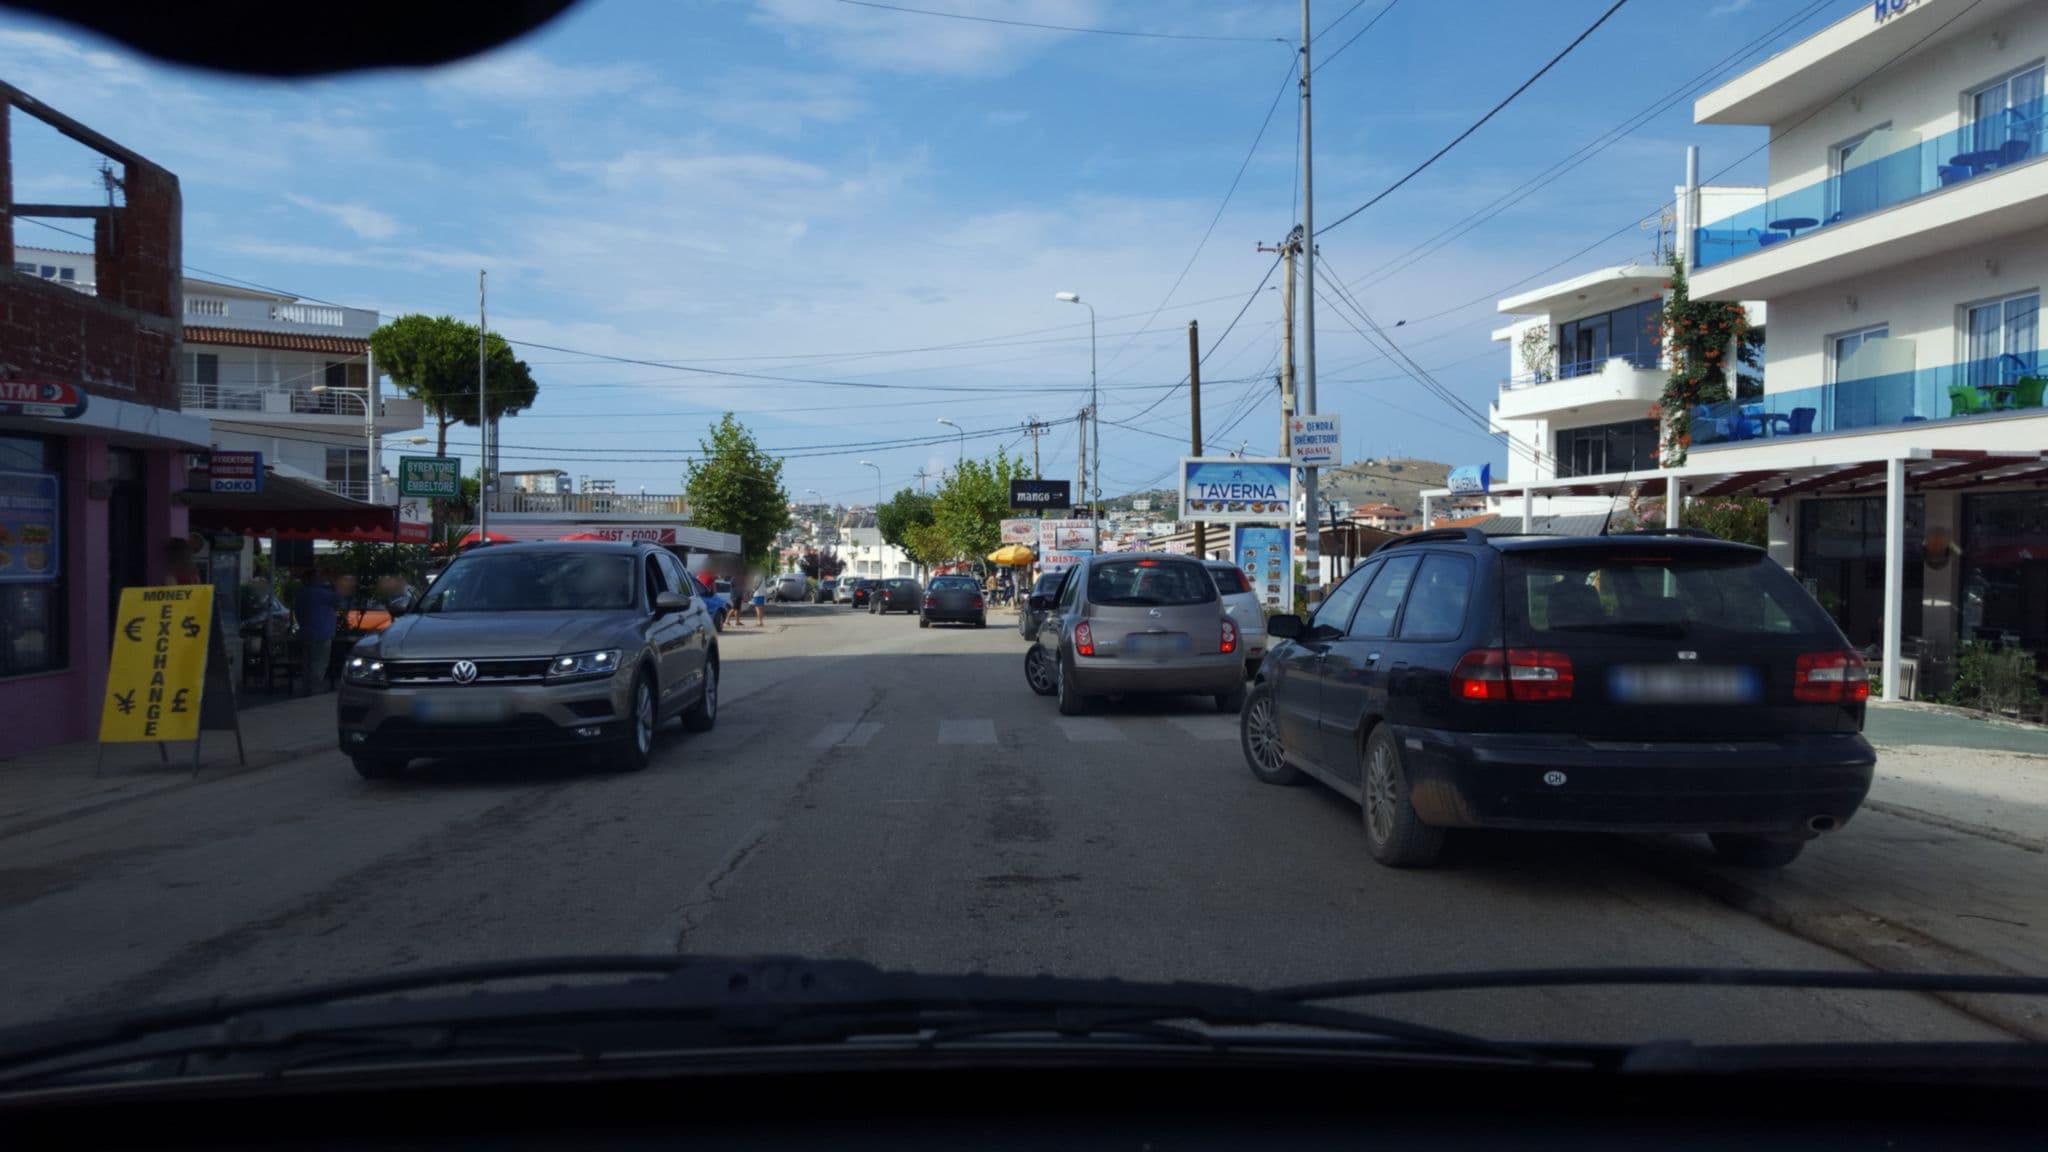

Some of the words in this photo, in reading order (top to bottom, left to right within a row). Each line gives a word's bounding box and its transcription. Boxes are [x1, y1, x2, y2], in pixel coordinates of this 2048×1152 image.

[407, 461, 455, 473] BYREKTORE
[215, 481, 252, 490] DOKO
[1197, 483, 1277, 499] TAVERNA
[599, 530, 624, 541] FAST
[631, 530, 658, 540] FOOD
[143, 590, 193, 601] MONEY
[144, 605, 173, 736] EXCHANGE
